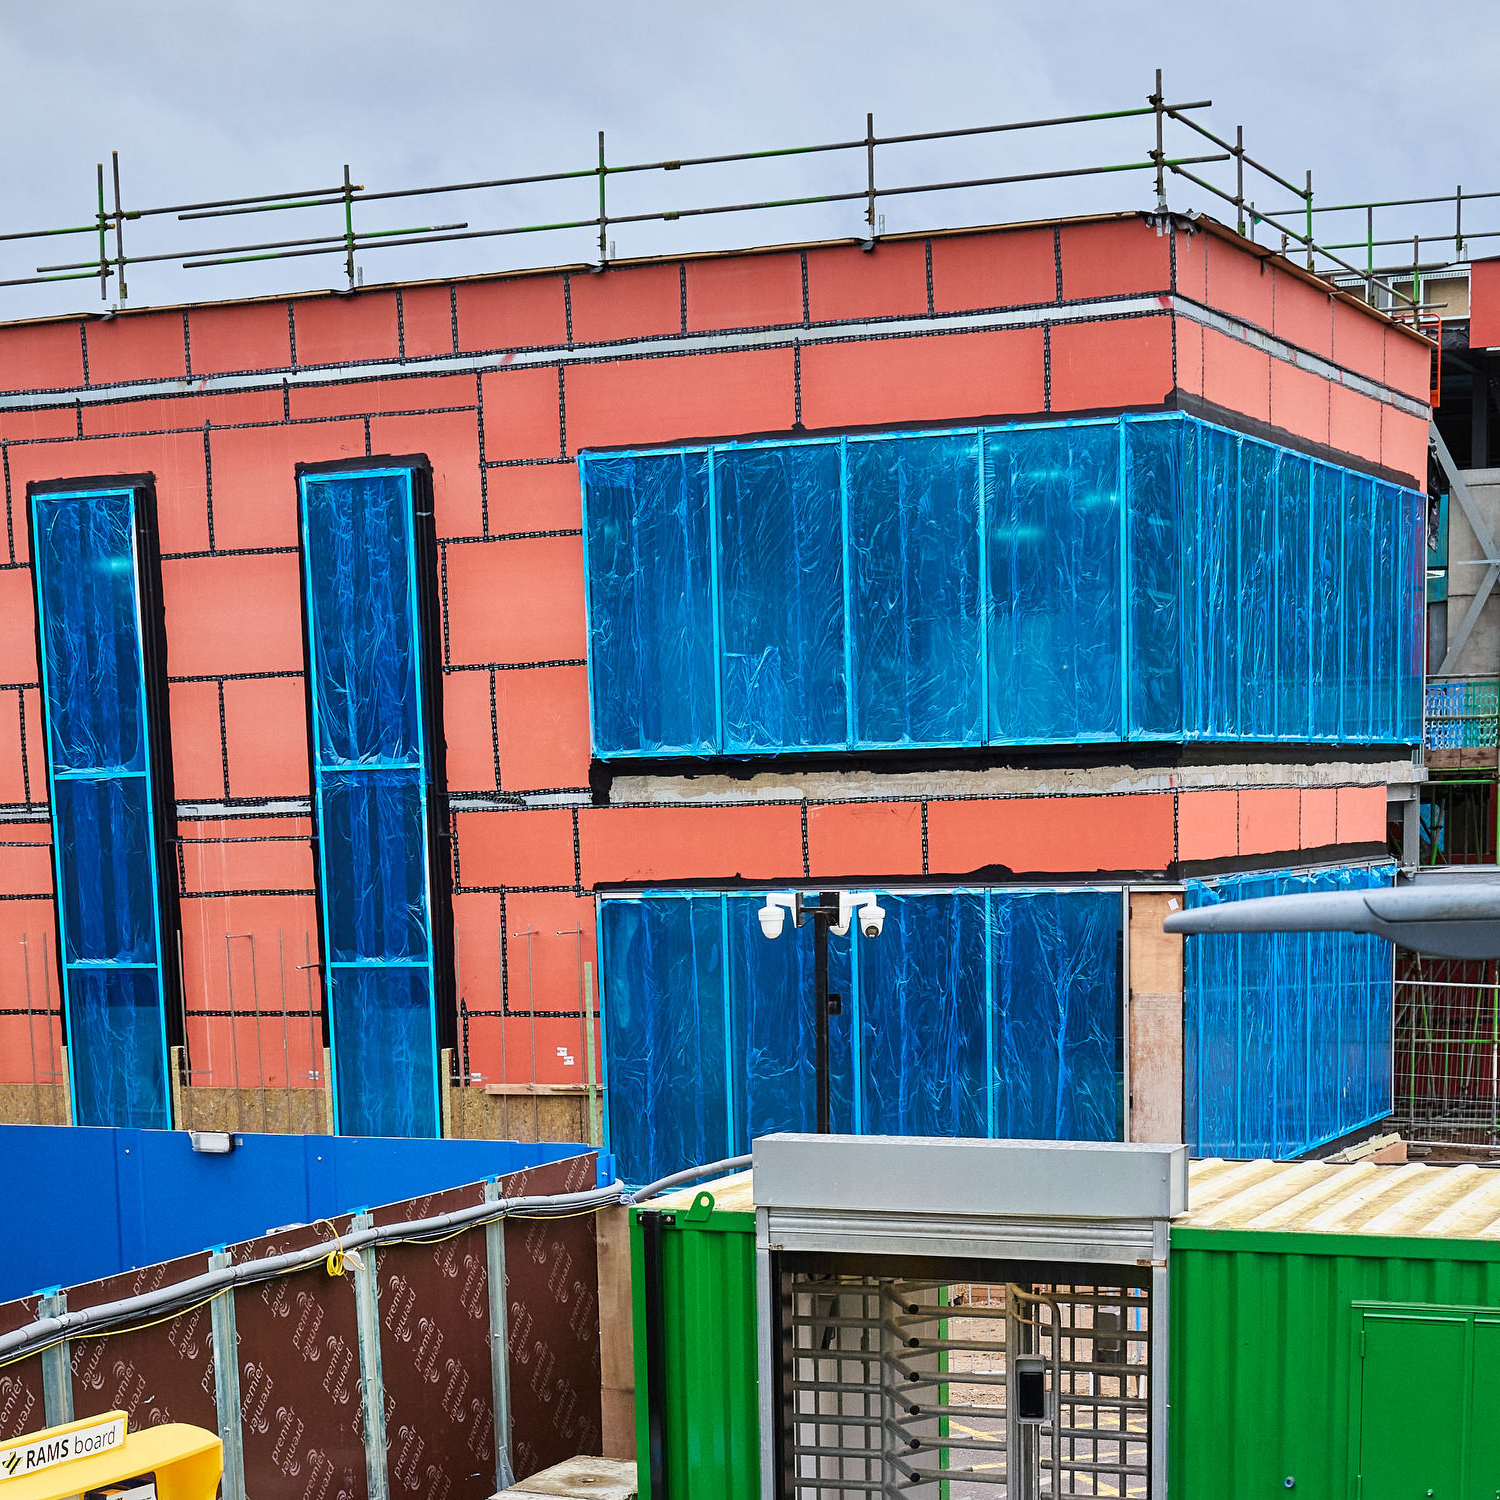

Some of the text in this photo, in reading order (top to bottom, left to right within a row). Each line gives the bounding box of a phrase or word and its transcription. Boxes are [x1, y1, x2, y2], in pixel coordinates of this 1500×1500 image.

[322, 1335, 345, 1395] premier
[26, 1426, 116, 1468] RAMS board
[271, 1406, 296, 1467] premier
